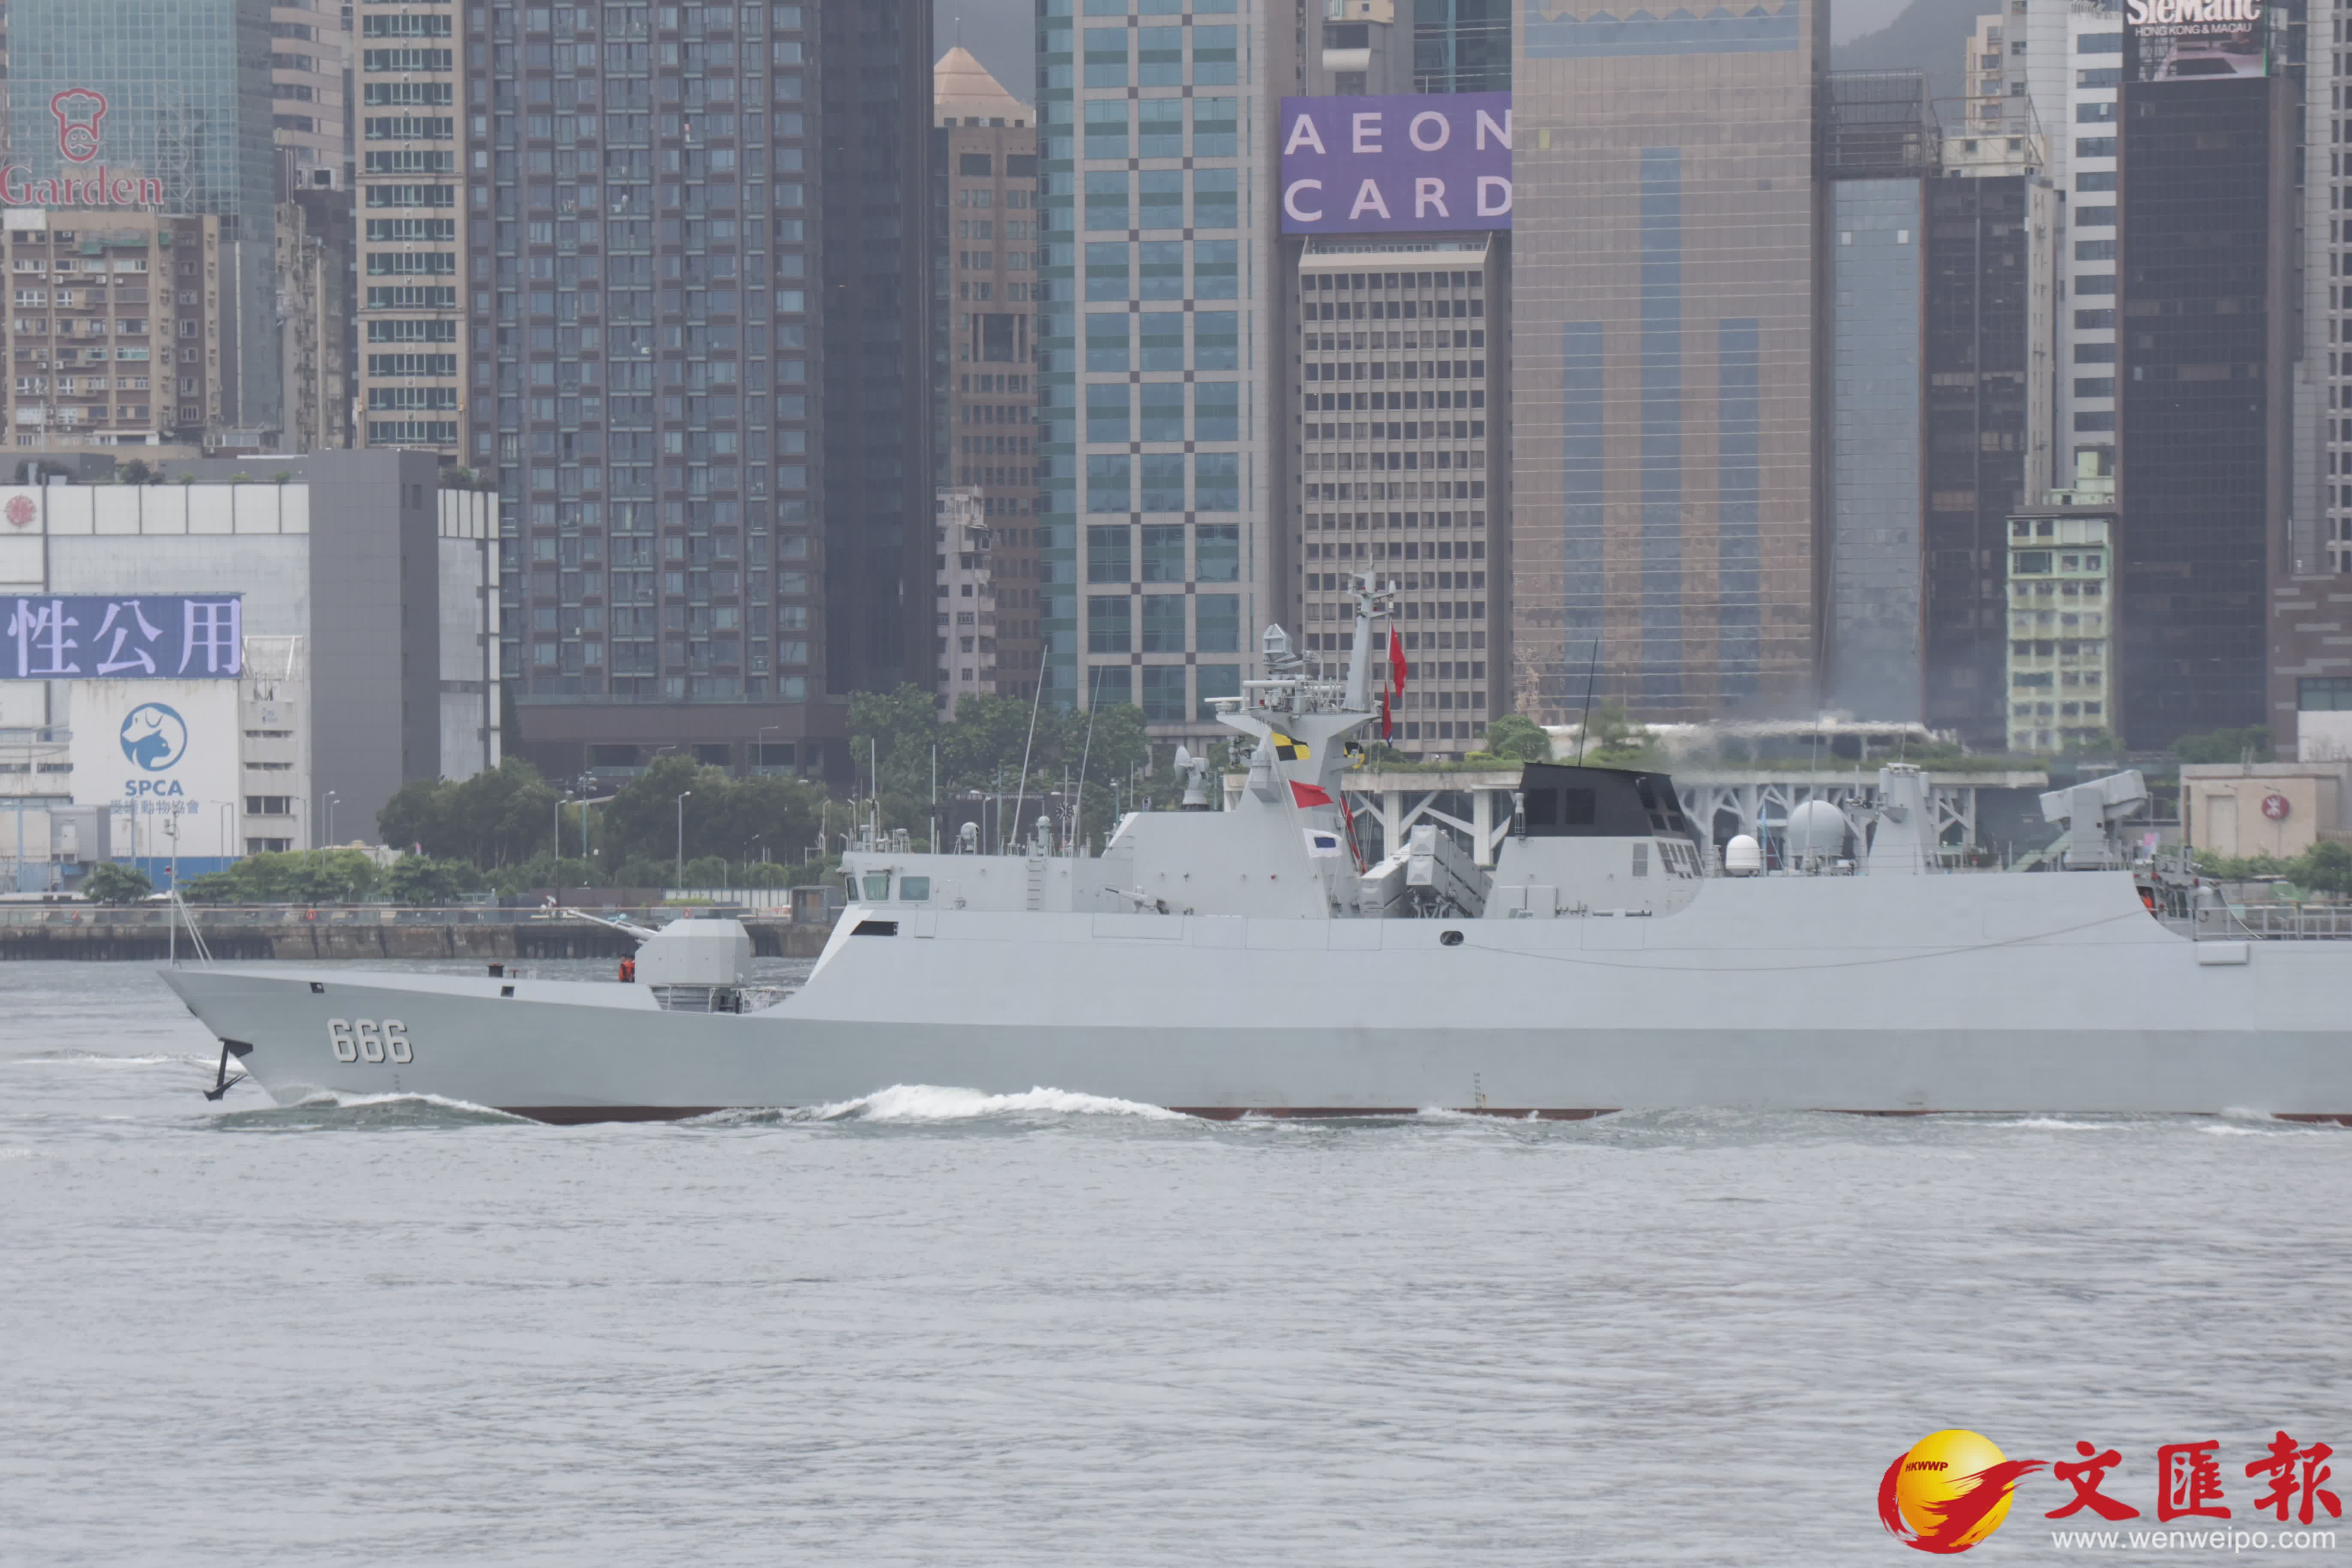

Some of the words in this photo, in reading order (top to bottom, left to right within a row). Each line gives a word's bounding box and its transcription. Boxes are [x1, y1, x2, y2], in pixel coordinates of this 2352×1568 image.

[2135, 26, 2167, 37] HONG
[2169, 24, 2200, 34] KONG
[2201, 24, 2210, 34] &
[2211, 23, 2252, 33] MACAU
[1284, 109, 1512, 155] AEON
[0, 164, 164, 206] Garden
[1284, 176, 1512, 222] CARD
[7, 598, 242, 677] 性公用
[125, 779, 184, 797] SPCA
[327, 1018, 413, 1064] 666
